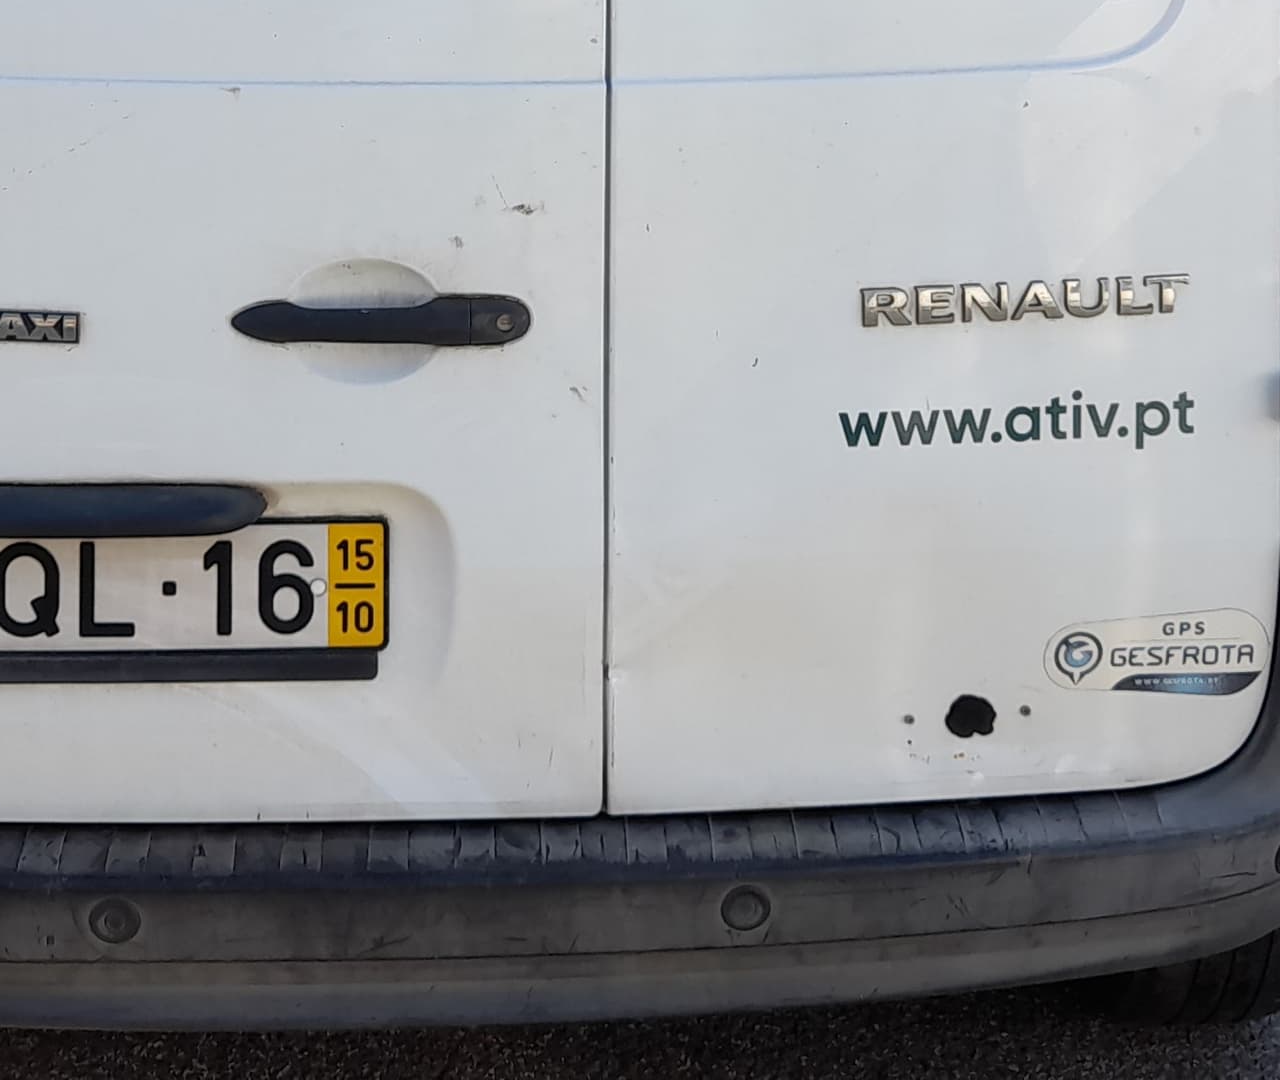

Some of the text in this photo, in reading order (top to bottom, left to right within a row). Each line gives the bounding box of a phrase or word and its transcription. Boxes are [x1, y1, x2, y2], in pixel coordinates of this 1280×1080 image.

[859, 273, 1190, 328] RENAULT
[838, 390, 1195, 450] www.ativ.pt
[336, 538, 375, 571] 15
[336, 600, 374, 634] 10
[1161, 621, 1206, 637] GPS
[1110, 644, 1255, 668] GESFROTA
